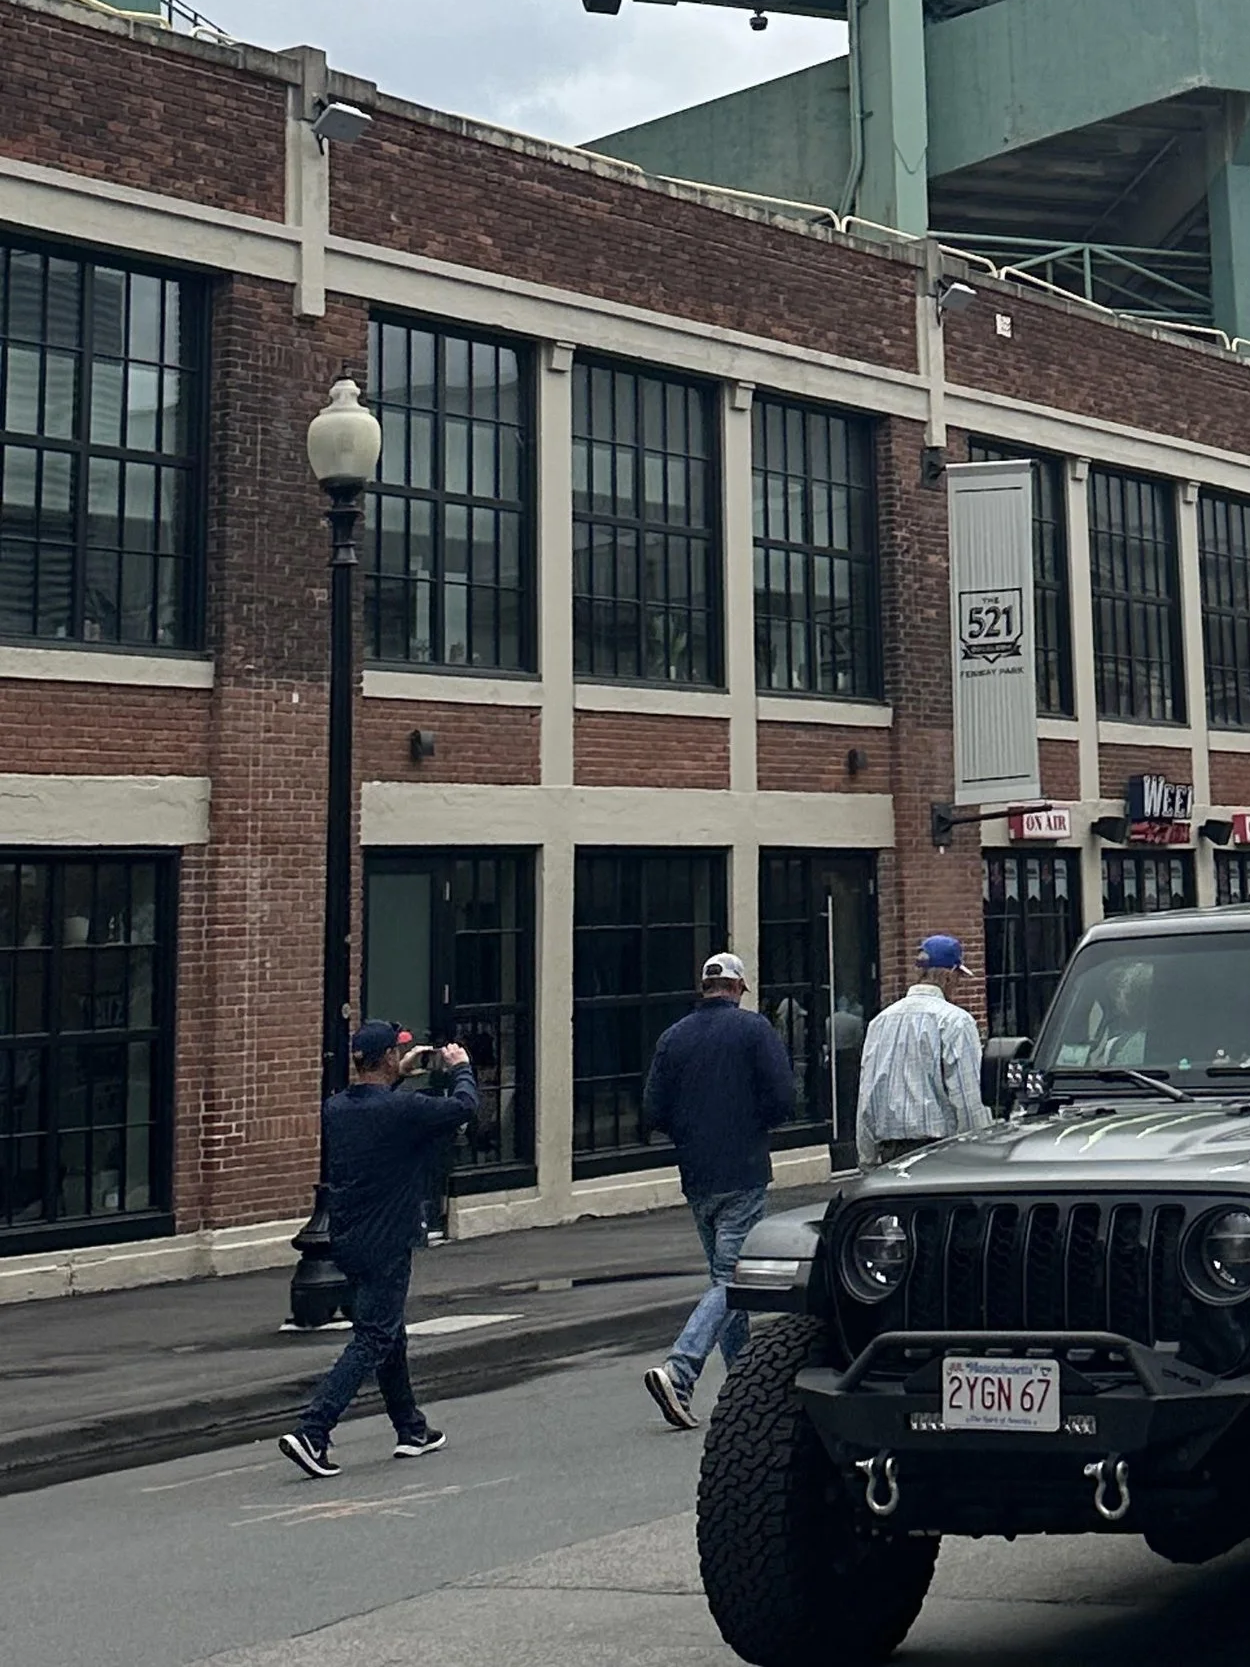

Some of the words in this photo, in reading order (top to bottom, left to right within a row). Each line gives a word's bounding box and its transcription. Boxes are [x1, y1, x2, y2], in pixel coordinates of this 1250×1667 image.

[968, 605, 1013, 639] 521
[1026, 814, 1042, 832] ON
[1046, 812, 1067, 832] AIR
[948, 1376, 1012, 1411] 2YGN
[1020, 1379, 1051, 1413] 67
